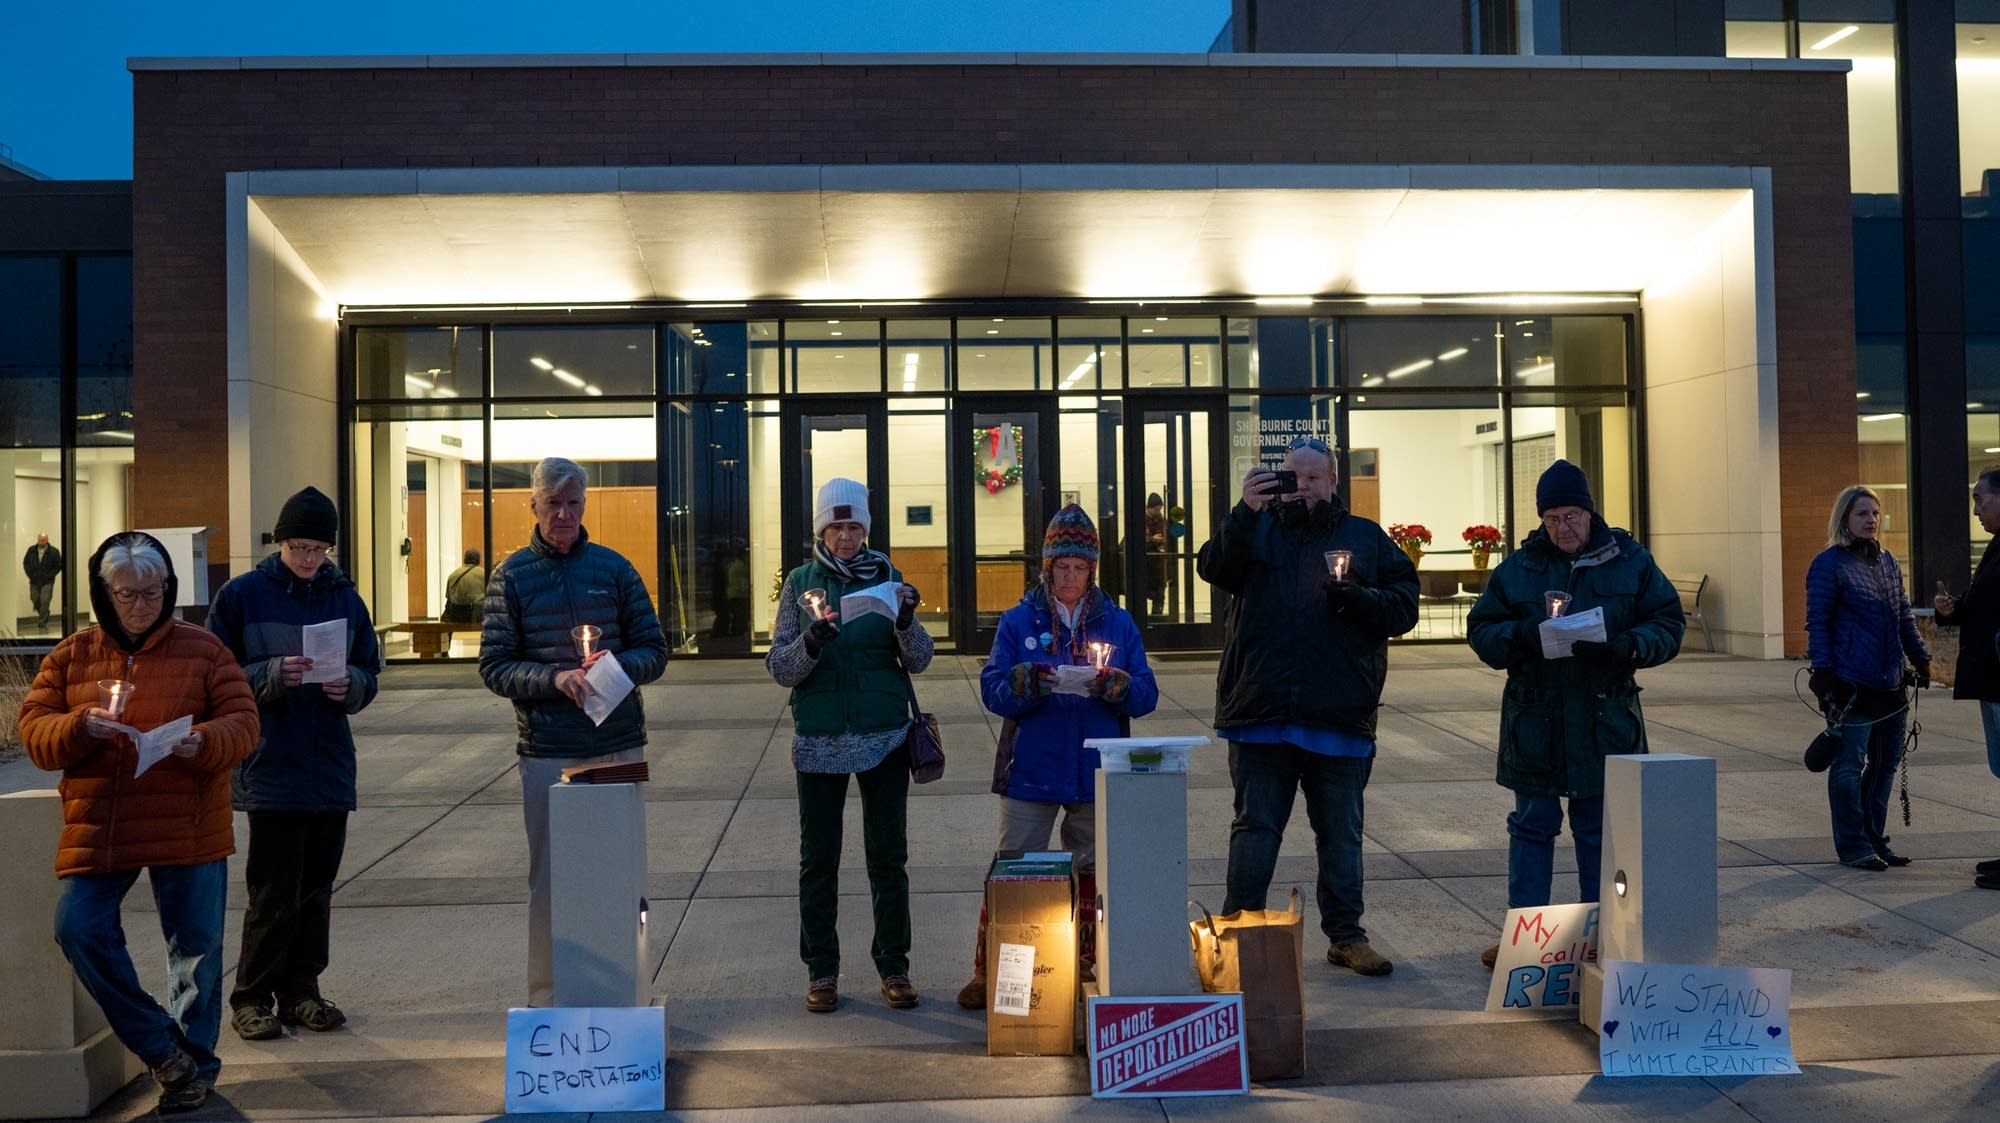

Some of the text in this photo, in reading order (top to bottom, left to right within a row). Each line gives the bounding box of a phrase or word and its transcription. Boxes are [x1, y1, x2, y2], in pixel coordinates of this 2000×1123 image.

[1236, 419, 1333, 432] SHERBURNE COUNTY
[1512, 912, 1559, 950] My
[1541, 943, 1598, 964] calls
[1502, 964, 1581, 1008] RE
[1616, 971, 1771, 1018] WE STAND
[529, 1024, 611, 1057] END
[1100, 1006, 1155, 1049] NO MORE
[1630, 1019, 1759, 1048] WITH ALL
[1102, 1006, 1235, 1089] DEPORTATIONS!
[1603, 1050, 1791, 1075] IMMIGRANTS
[516, 1061, 662, 1097] DEPORTATIONS!
